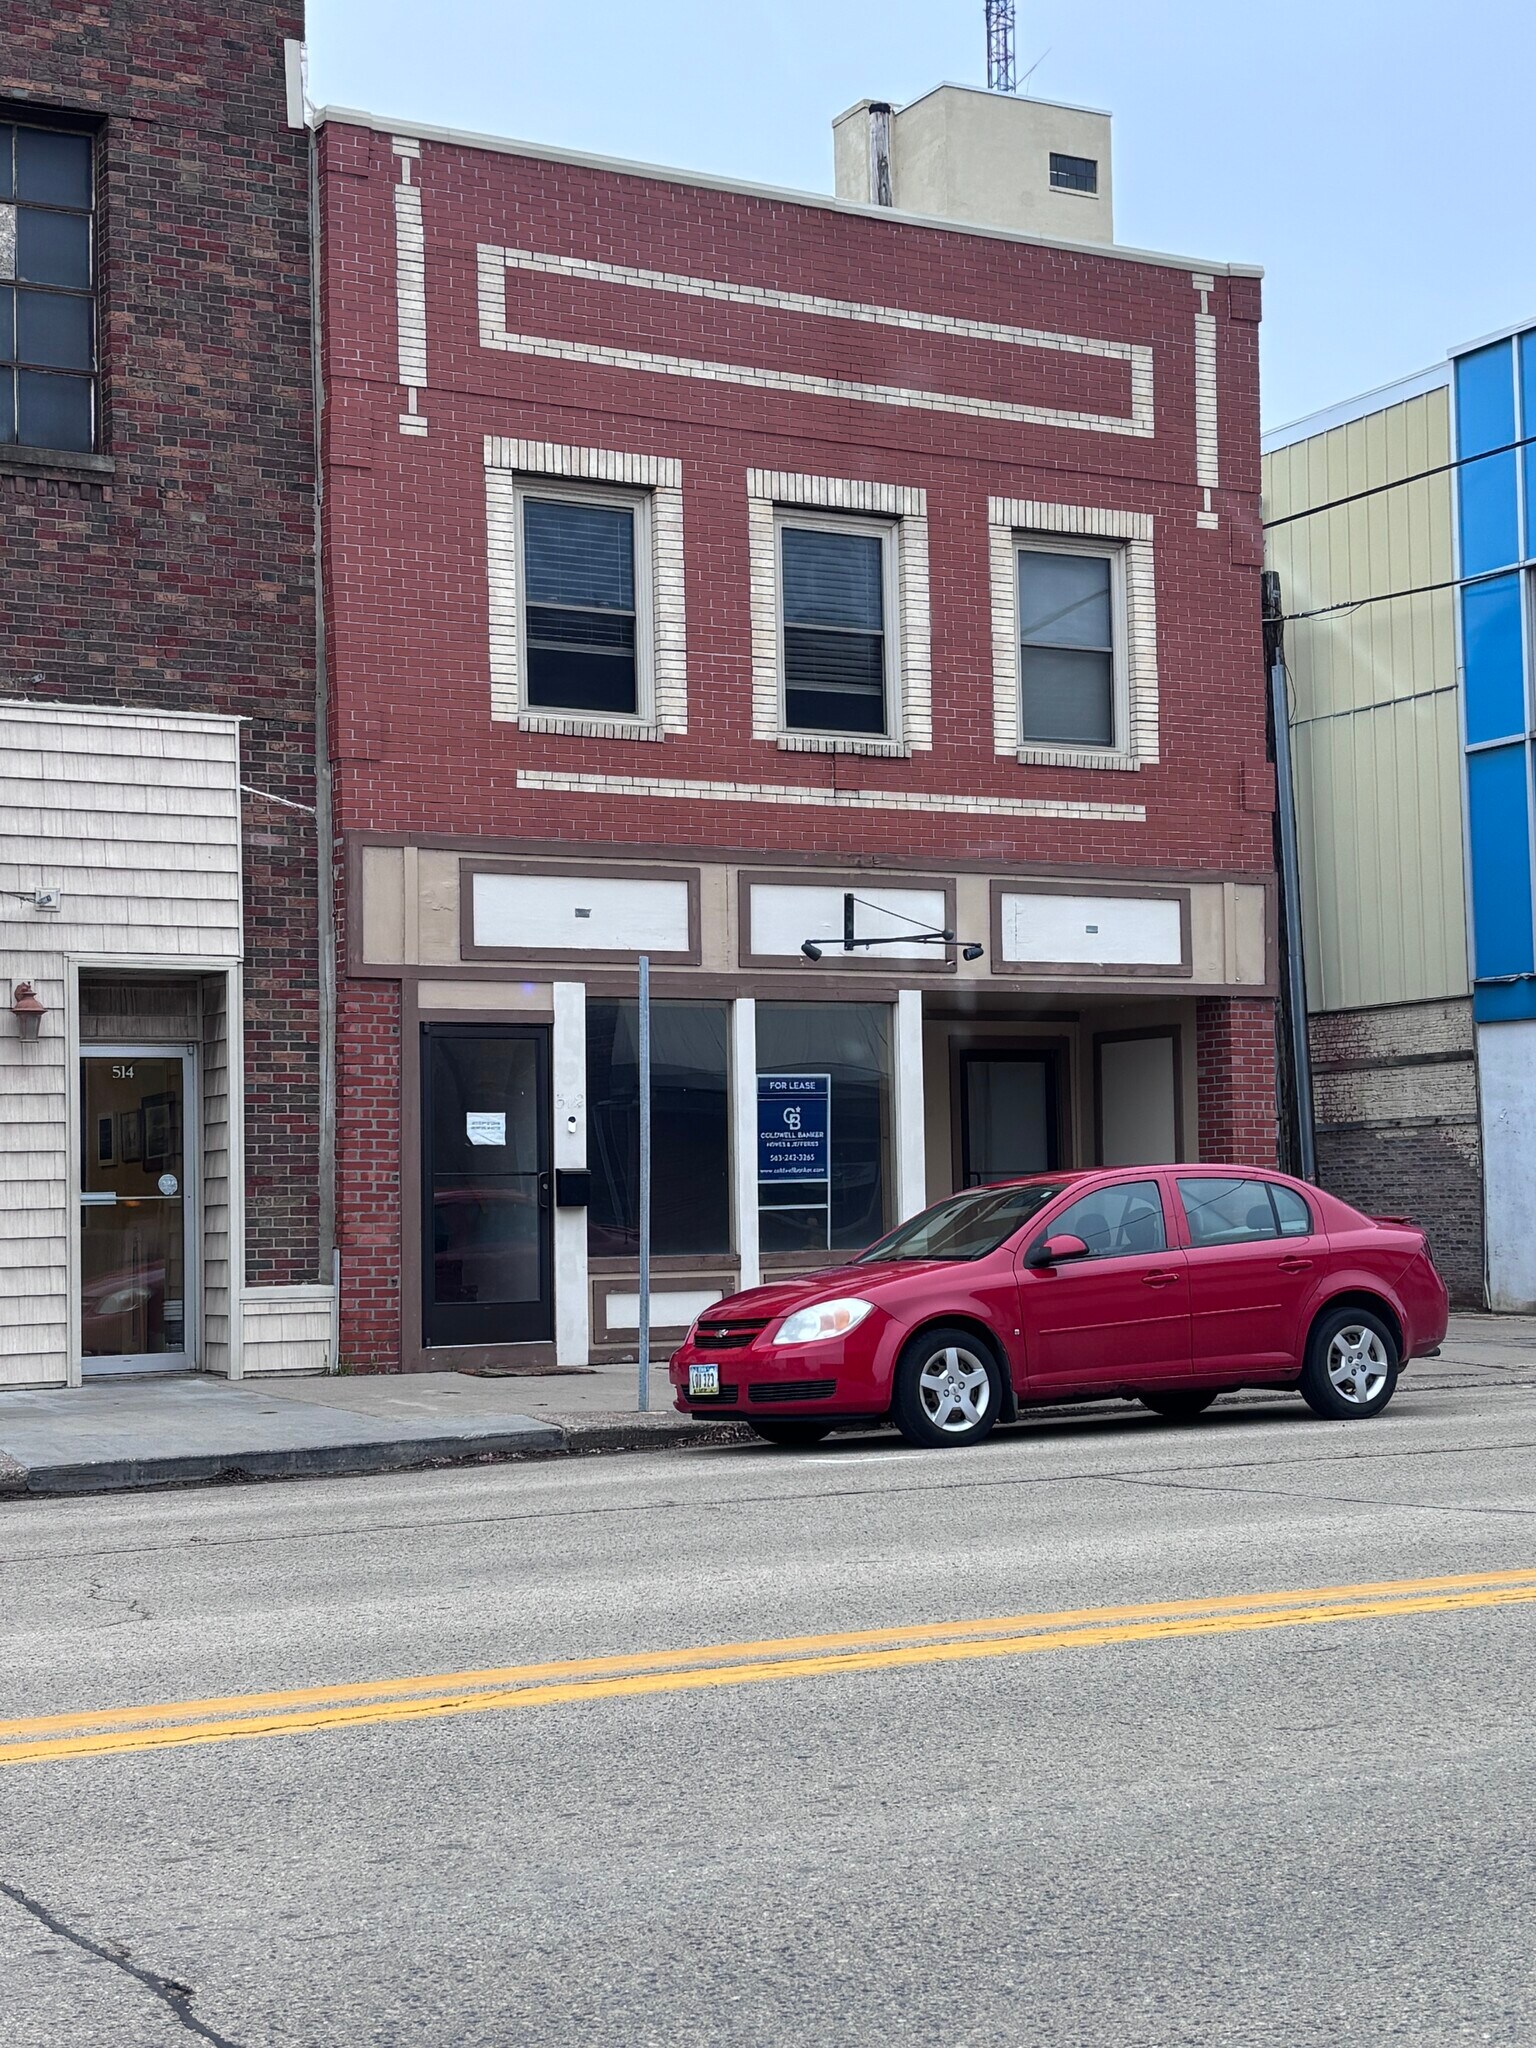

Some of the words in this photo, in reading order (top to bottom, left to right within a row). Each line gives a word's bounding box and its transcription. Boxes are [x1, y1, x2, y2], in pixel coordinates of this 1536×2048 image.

[112, 1065, 135, 1079] 514
[769, 1081, 787, 1090] FOR
[788, 1081, 816, 1090] LEASE
